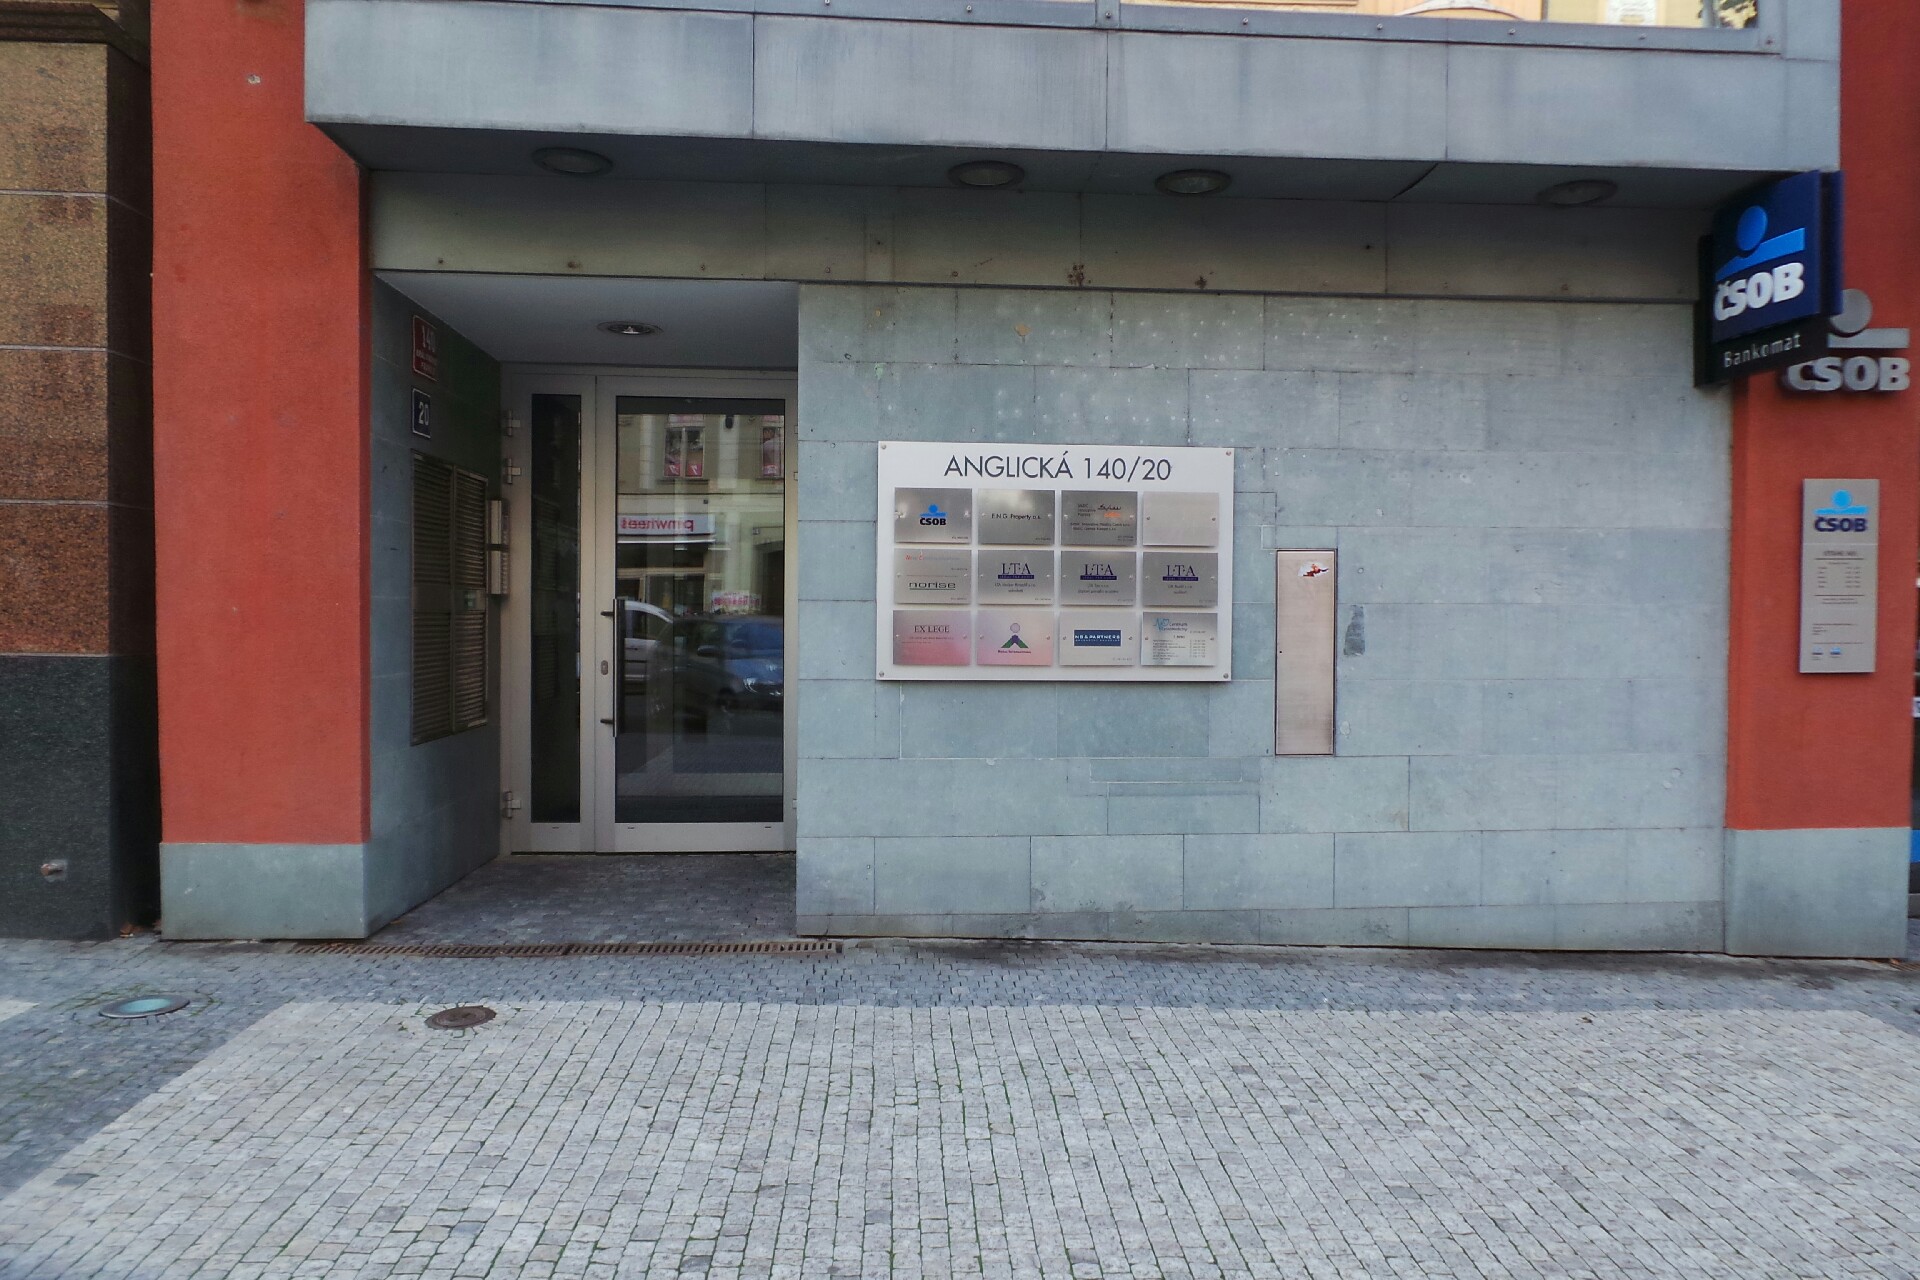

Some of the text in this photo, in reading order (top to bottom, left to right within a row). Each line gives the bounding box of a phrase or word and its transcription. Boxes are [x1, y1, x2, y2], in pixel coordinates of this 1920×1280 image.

[1713, 262, 1804, 321] ČSOB
[1724, 334, 1801, 368] Bankomat
[418, 401, 430, 426] 20
[944, 450, 1172, 483] ANGLICKÁ 140/20
[919, 516, 947, 526] ČSOB
[1814, 517, 1867, 532] ČSOB
[914, 625, 950, 633] EX LEGE
